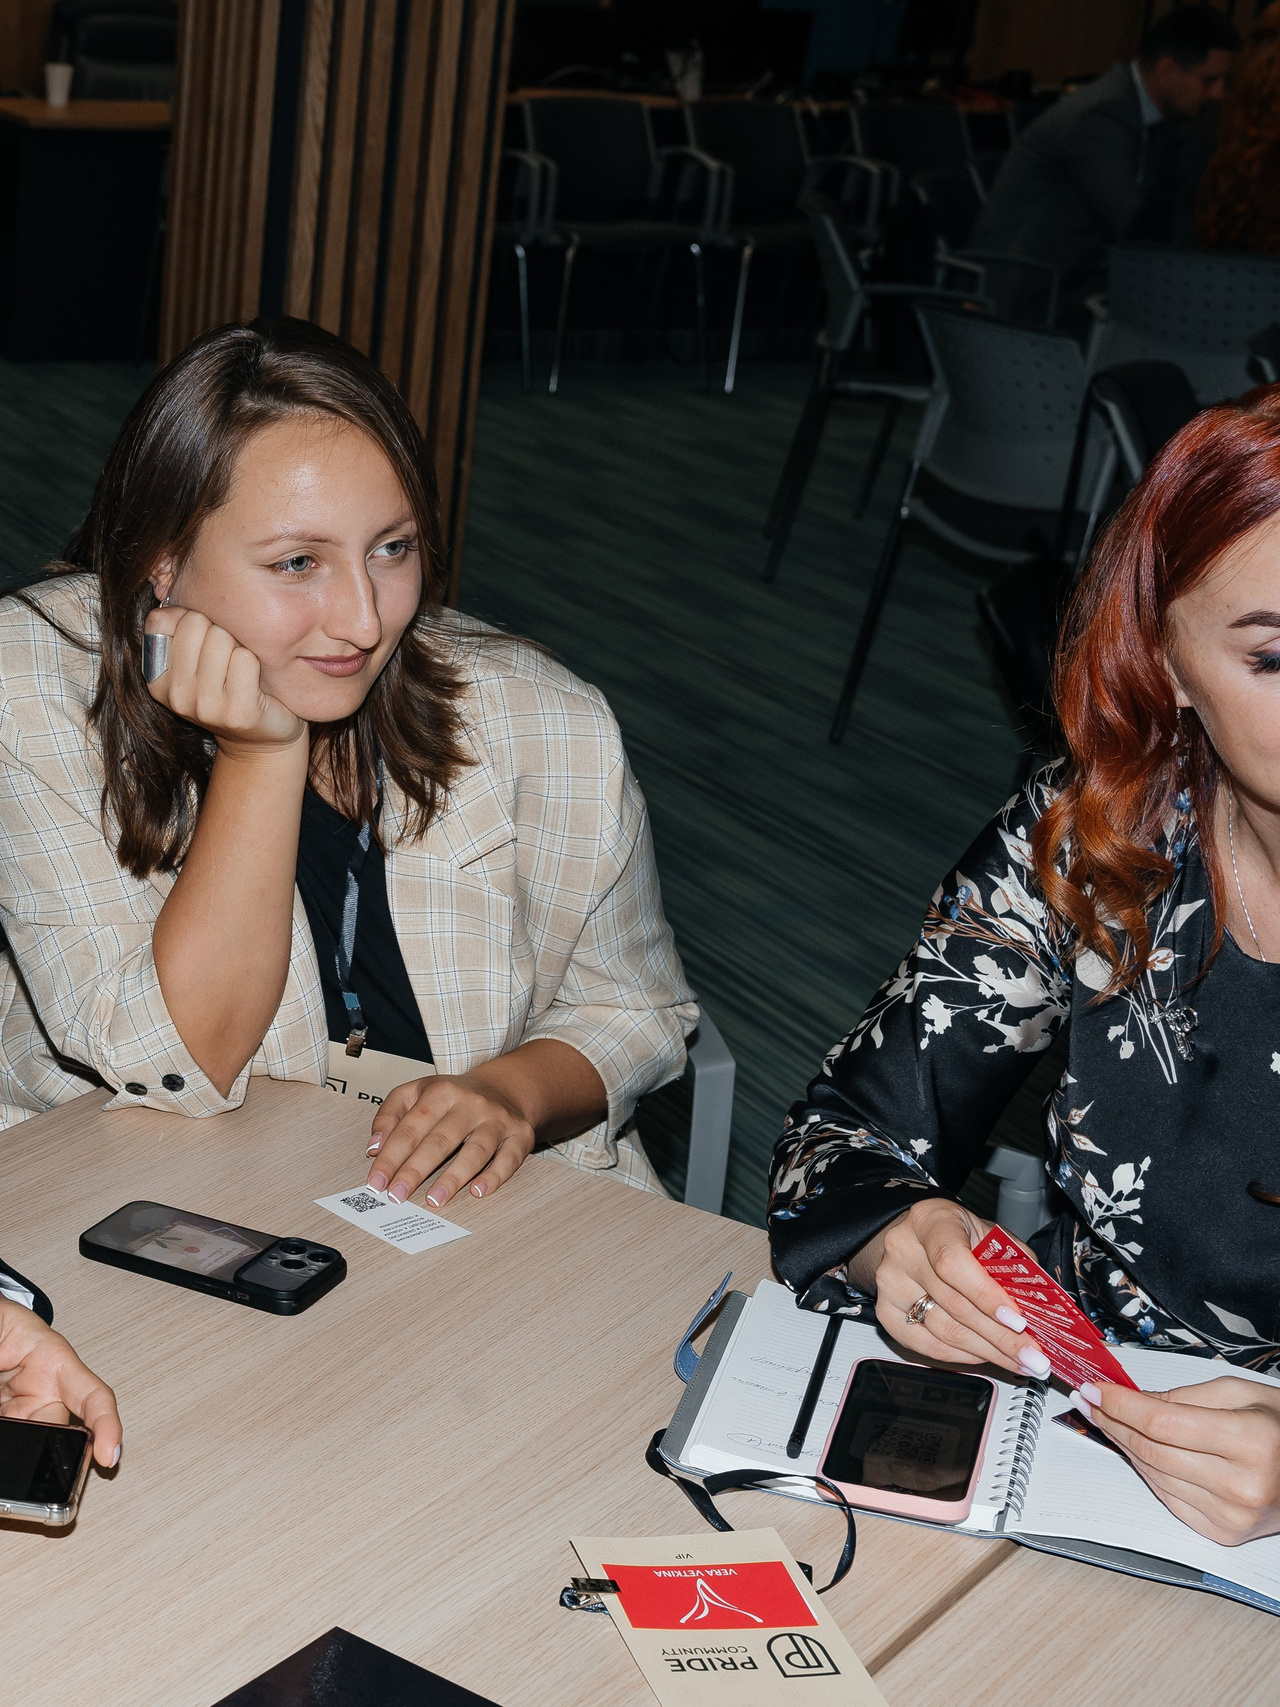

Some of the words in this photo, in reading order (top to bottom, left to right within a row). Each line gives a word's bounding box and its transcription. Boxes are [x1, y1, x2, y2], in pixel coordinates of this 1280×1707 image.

[357, 1091, 384, 1106] PR
[675, 1552, 694, 1560] VIP
[652, 1568, 705, 1578] VETKINA
[705, 1567, 738, 1577] VERA
[661, 1645, 749, 1656] COMMUNITY
[664, 1656, 760, 1672] PRIDE
